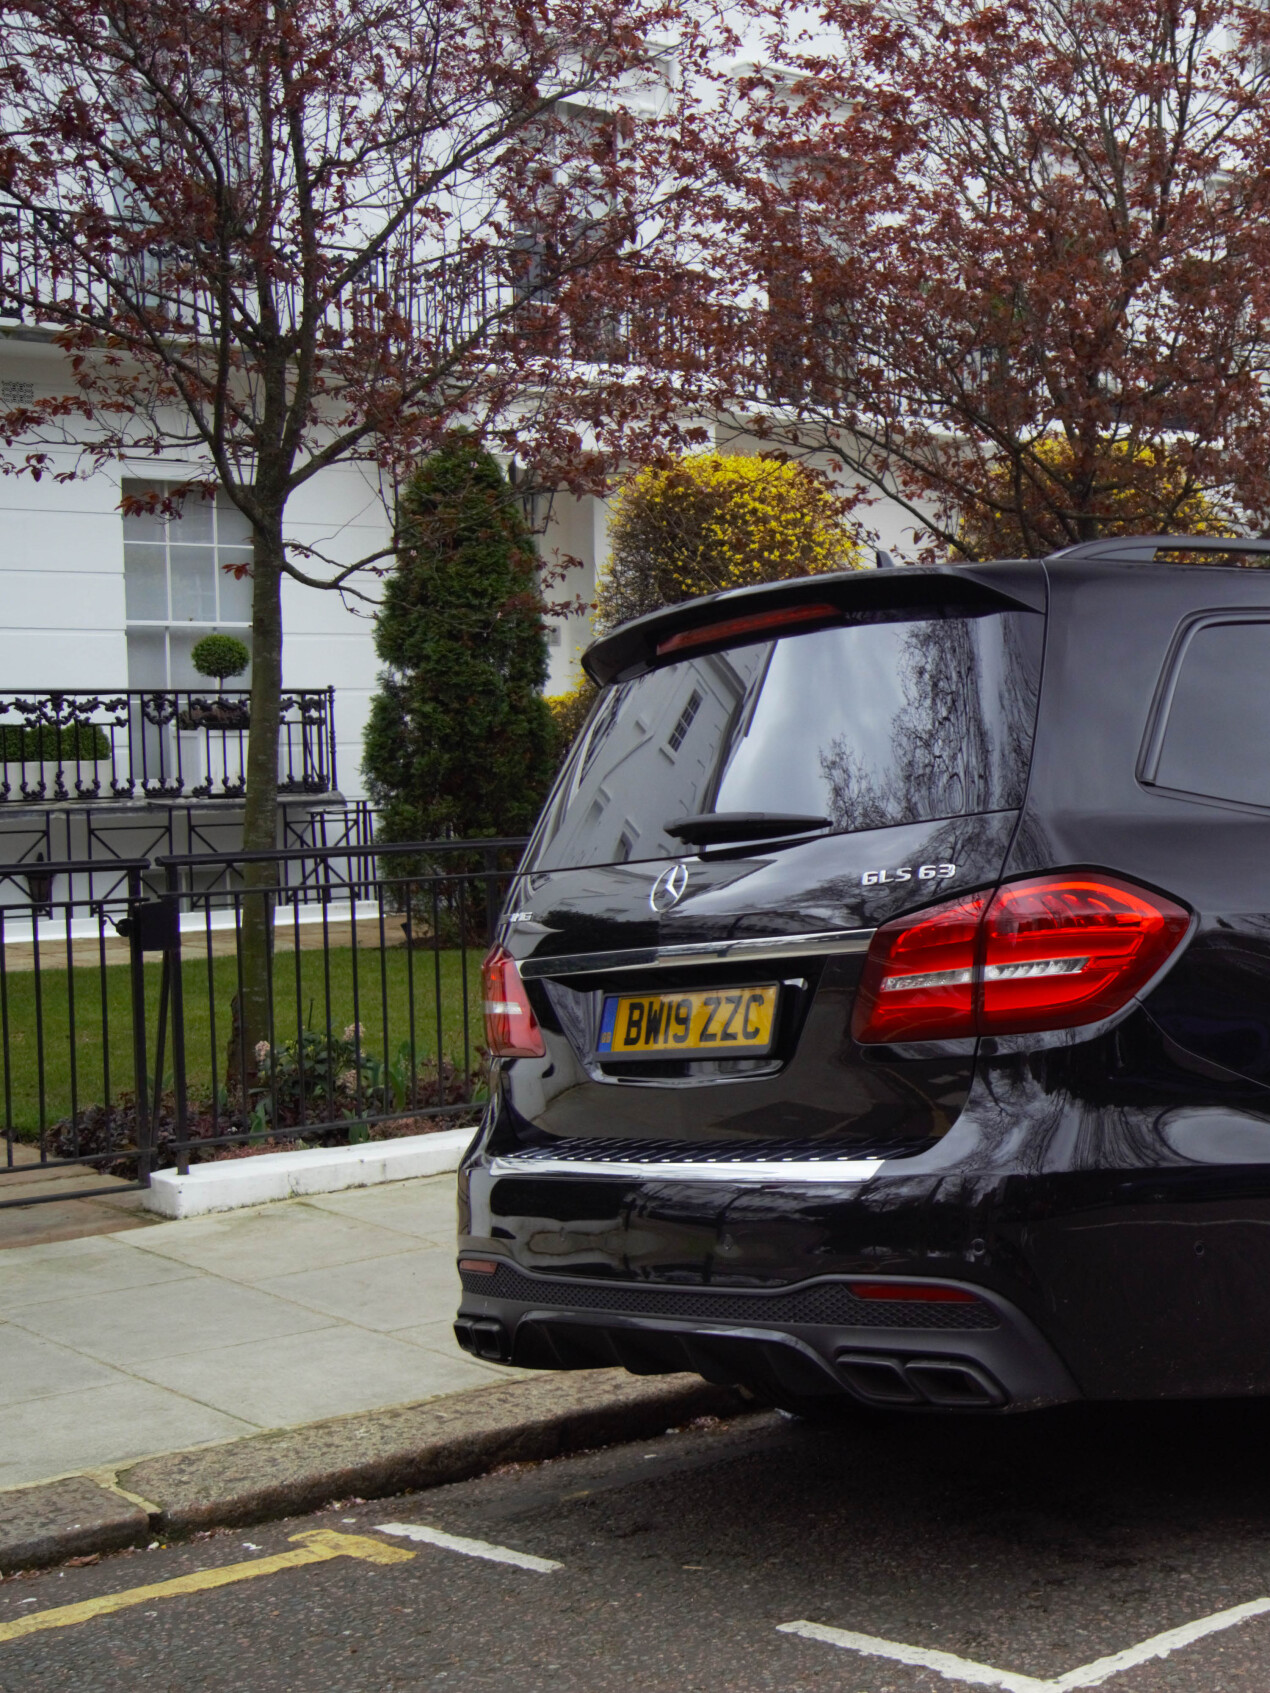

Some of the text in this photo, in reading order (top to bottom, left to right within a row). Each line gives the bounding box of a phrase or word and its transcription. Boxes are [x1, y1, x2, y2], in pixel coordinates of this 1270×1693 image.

[861, 863, 956, 886] GLS 63
[623, 993, 765, 1046] BW19 ZZC
